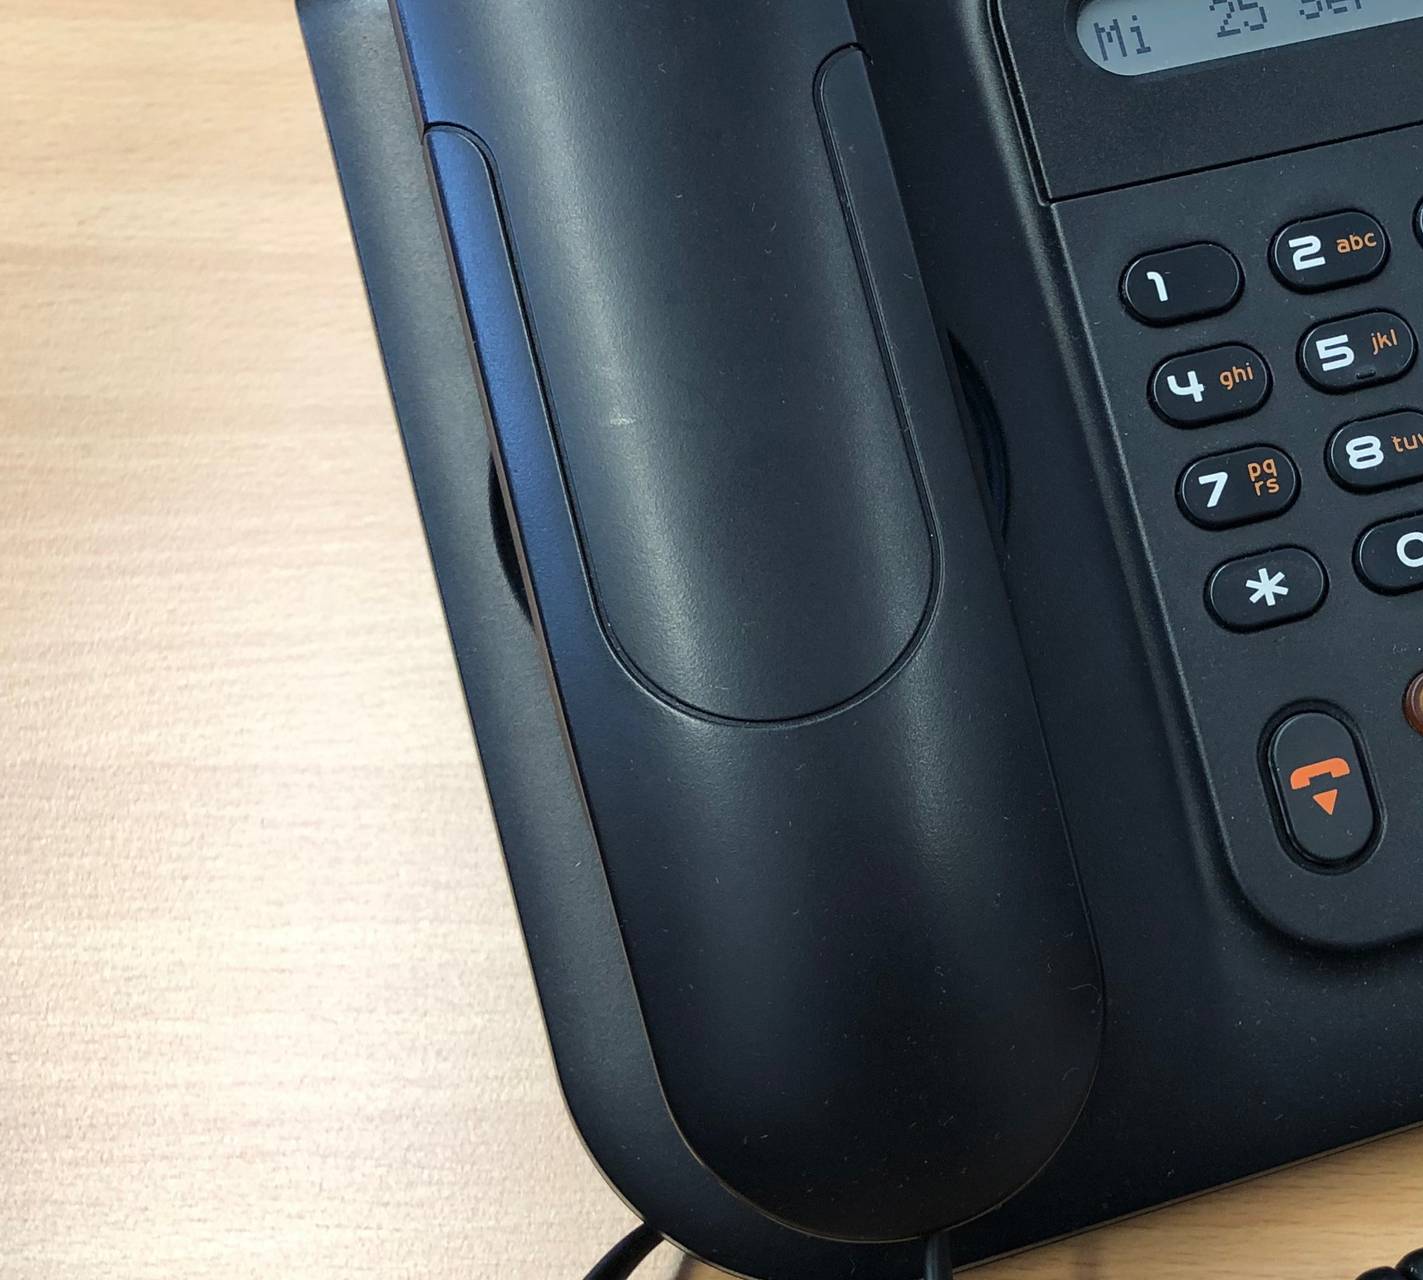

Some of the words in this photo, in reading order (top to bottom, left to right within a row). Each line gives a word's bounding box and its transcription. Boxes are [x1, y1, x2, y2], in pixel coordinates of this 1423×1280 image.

[1093, 14, 1152, 62] Mi
[1208, 0, 1268, 38] 25
[1299, 0, 1362, 20] Se
[1287, 234, 1327, 272] 2
[1335, 230, 1378, 254] abc
[1146, 271, 1169, 302] 1
[1314, 333, 1356, 372] 5
[1369, 328, 1399, 356] jkl
[1166, 370, 1205, 403] 4
[1219, 362, 1254, 391] ghi
[1345, 435, 1385, 470] 8
[1198, 471, 1229, 508] 7
[1247, 458, 1279, 482] pq
[1254, 477, 1281, 497] rs
